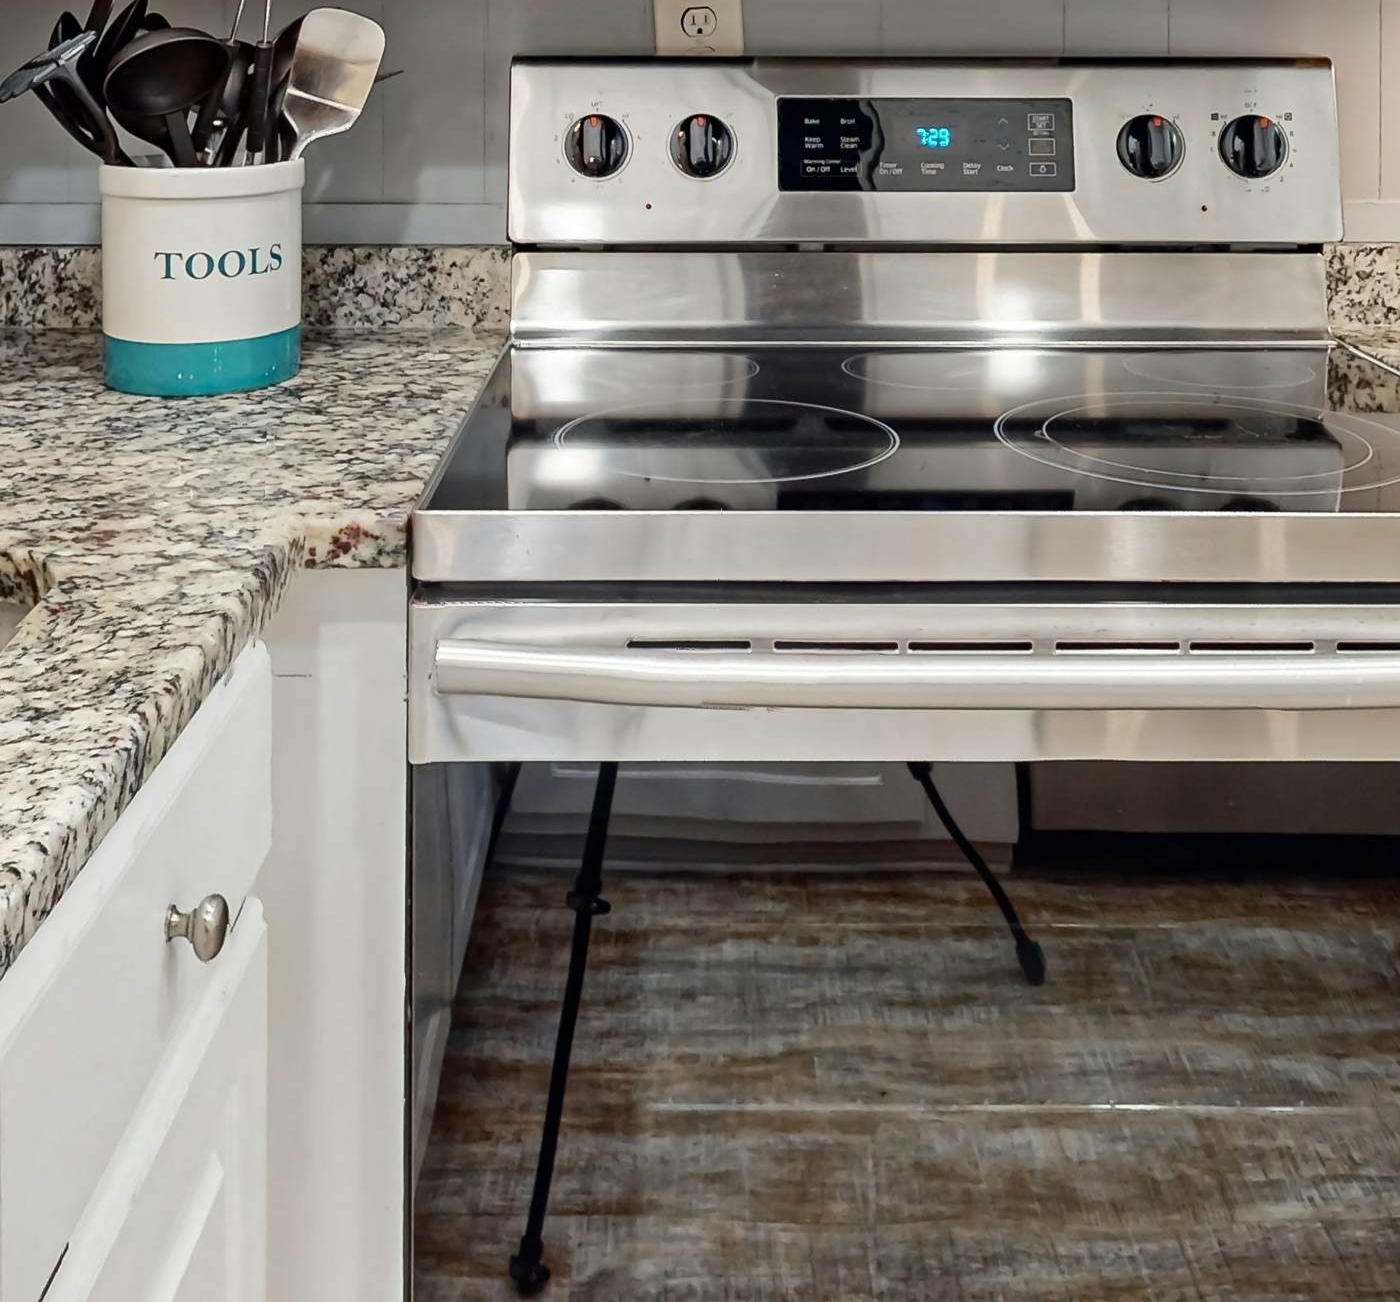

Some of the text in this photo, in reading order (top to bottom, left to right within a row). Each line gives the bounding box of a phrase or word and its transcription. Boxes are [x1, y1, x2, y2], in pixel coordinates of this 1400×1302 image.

[916, 127, 951, 147] 7:29
[962, 162, 982, 170] Delay
[996, 164, 1014, 172] Clock
[154, 243, 282, 280] TOOLS
